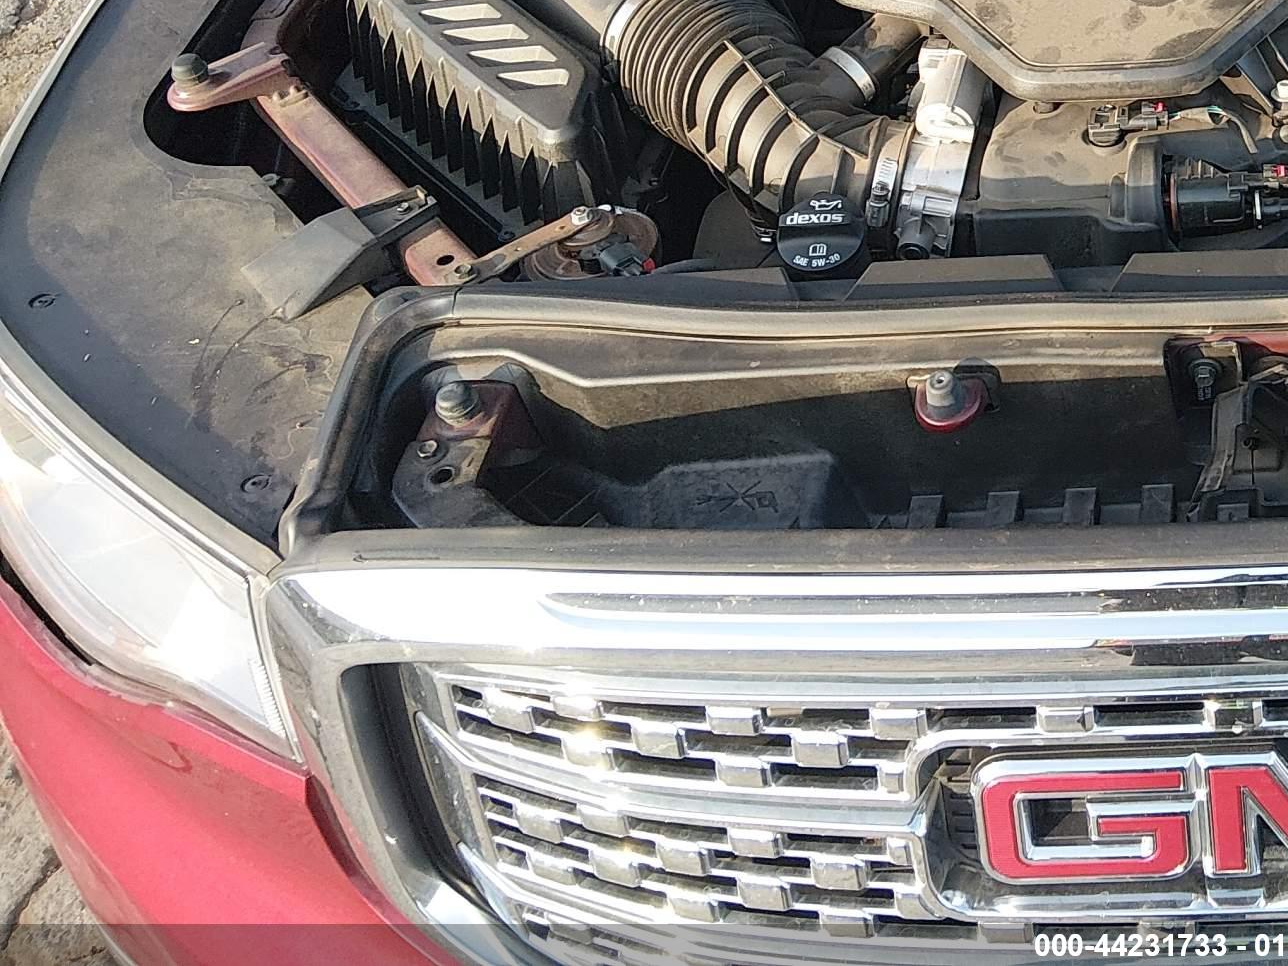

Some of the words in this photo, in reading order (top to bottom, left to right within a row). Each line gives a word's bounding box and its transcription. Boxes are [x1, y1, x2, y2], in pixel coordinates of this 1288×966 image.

[786, 212, 845, 225] dexos
[793, 255, 809, 266] SAE
[812, 253, 841, 267] 5W-30
